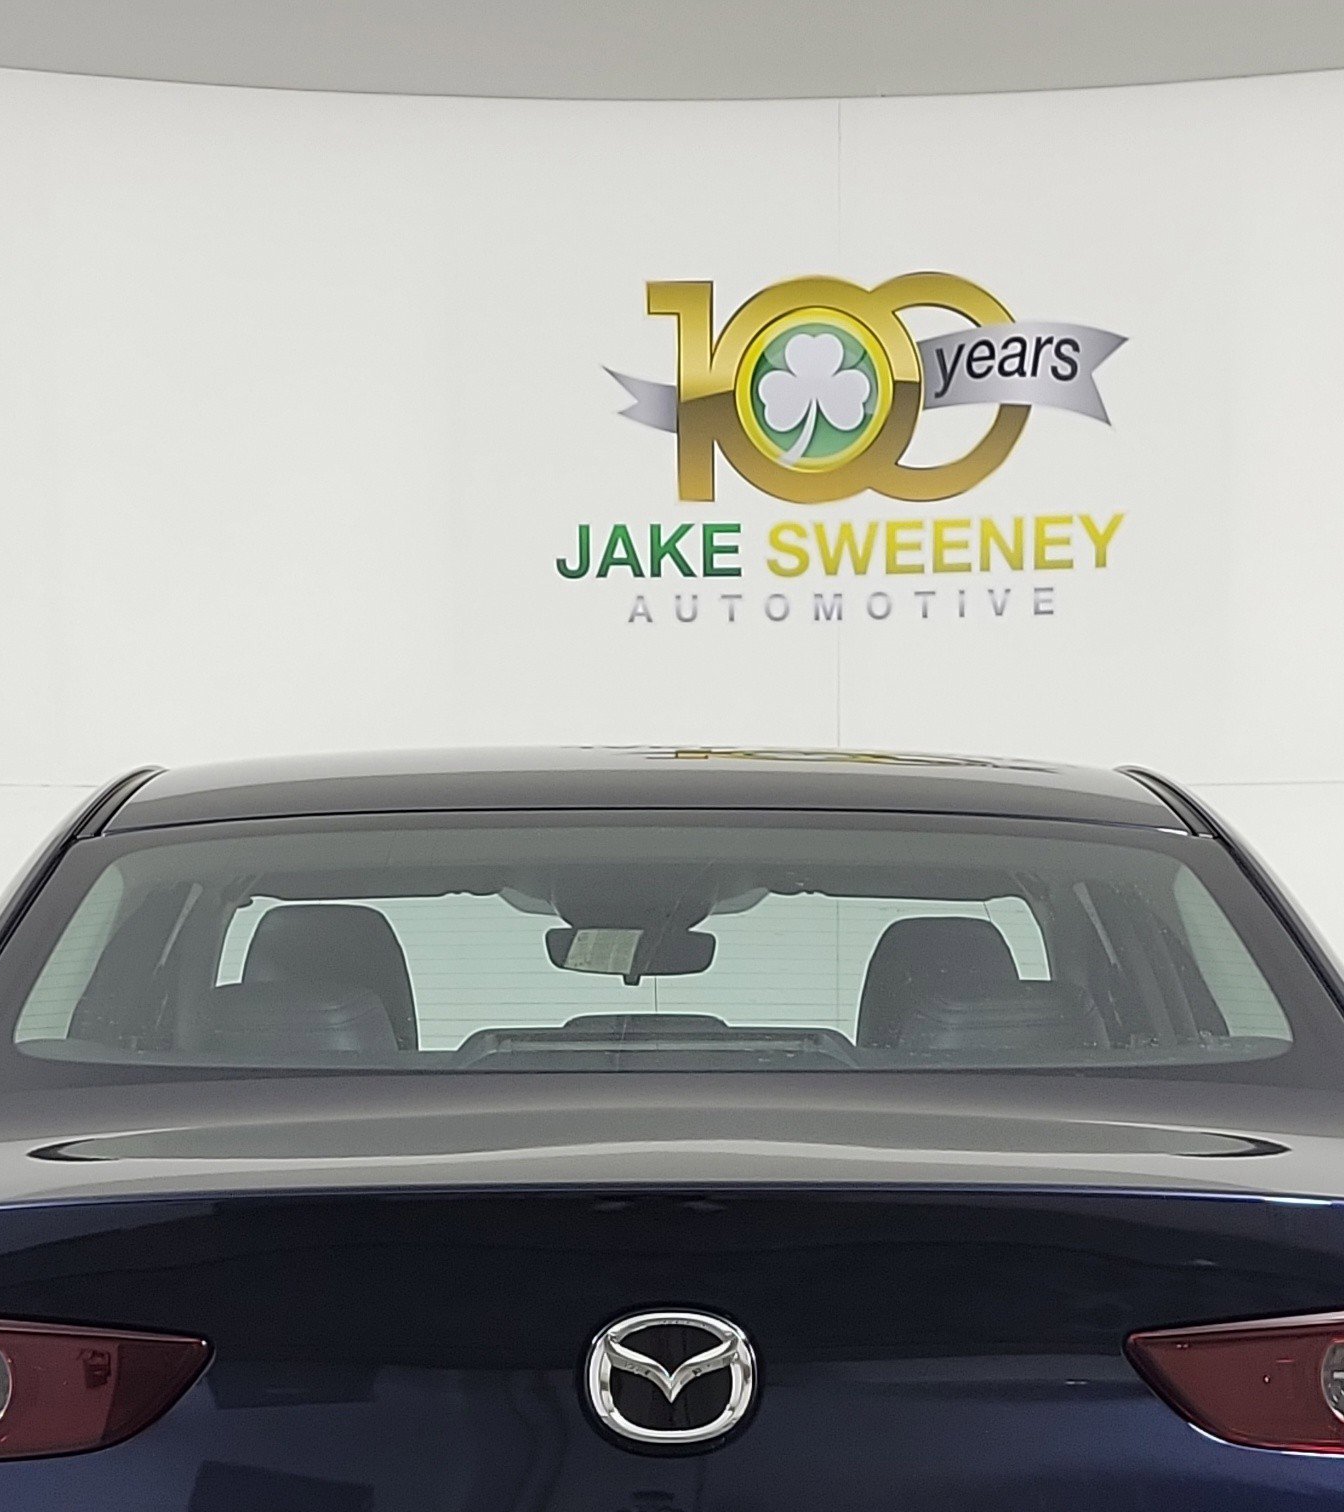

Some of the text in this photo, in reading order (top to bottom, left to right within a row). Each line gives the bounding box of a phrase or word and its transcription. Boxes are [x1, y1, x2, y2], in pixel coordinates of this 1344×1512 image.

[644, 271, 1081, 504] 100 years
[556, 513, 1126, 578] JAKE SWEENEY
[628, 587, 1055, 623] AUTOMOTIVE
